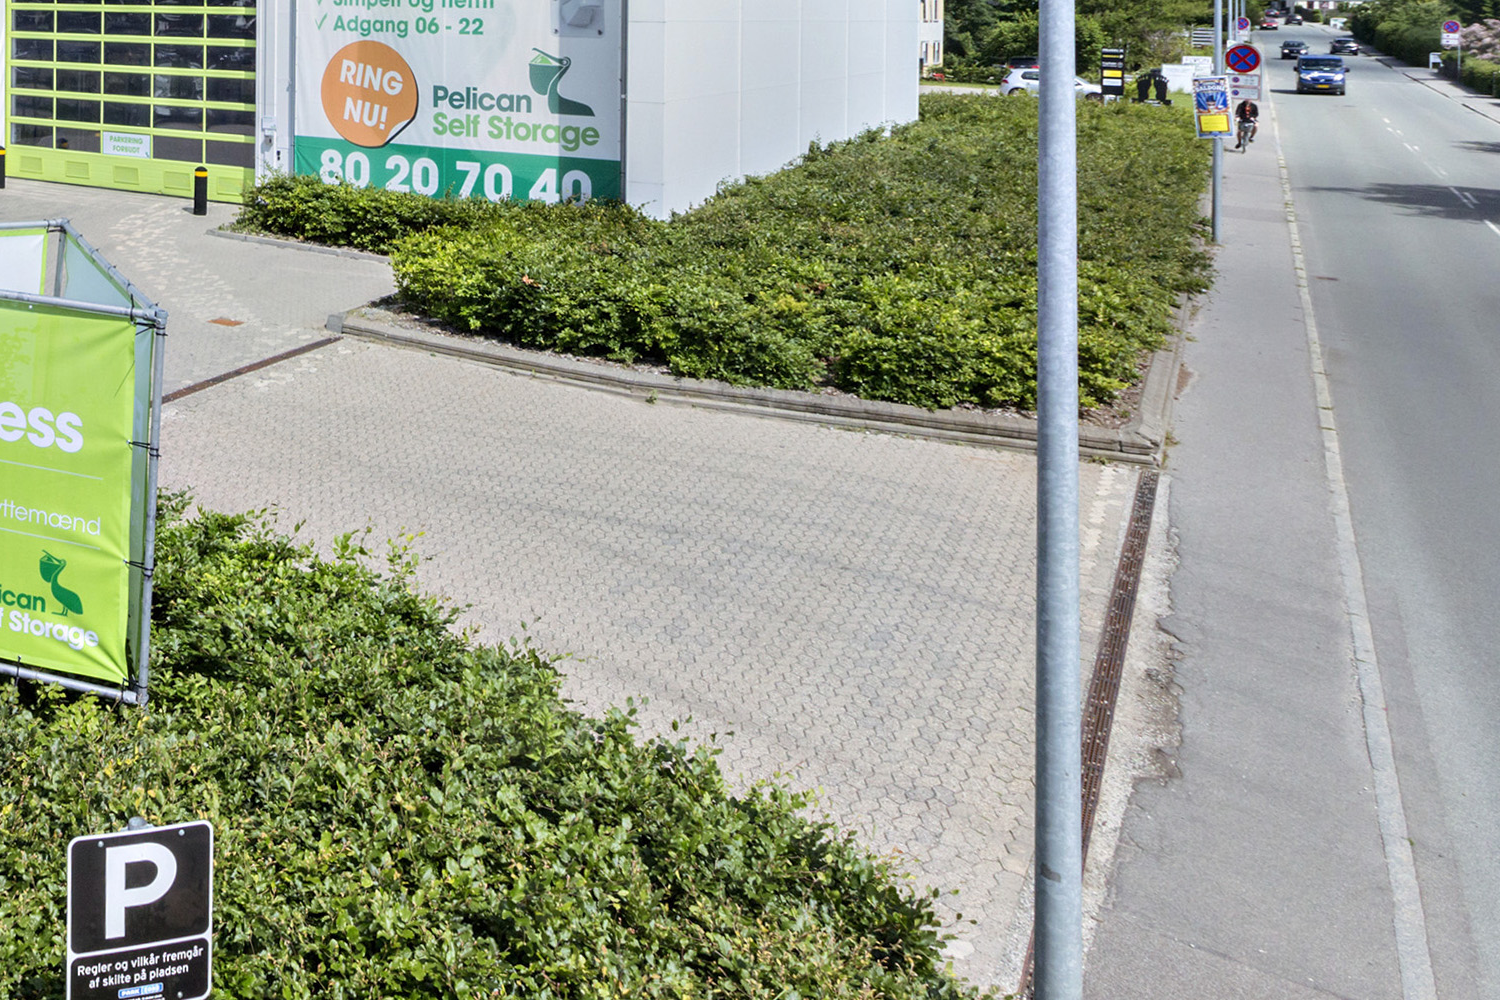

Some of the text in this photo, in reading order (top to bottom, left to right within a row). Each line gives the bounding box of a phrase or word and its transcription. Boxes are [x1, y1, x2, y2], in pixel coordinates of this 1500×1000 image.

[333, 15, 409, 38] Adgang
[415, 17, 440, 34] 06
[458, 18, 484, 35] 22
[339, 58, 404, 96] RING
[342, 97, 388, 131] NU!
[432, 85, 532, 114] Pelican
[432, 112, 600, 152] Self Storage
[319, 149, 592, 207] 80 20 70 40
[9, 610, 99, 651] Storage
[105, 842, 178, 940] P
[77, 945, 204, 977] Regler og vilkår fremgår
[89, 964, 189, 989] af skilte på pladsen
